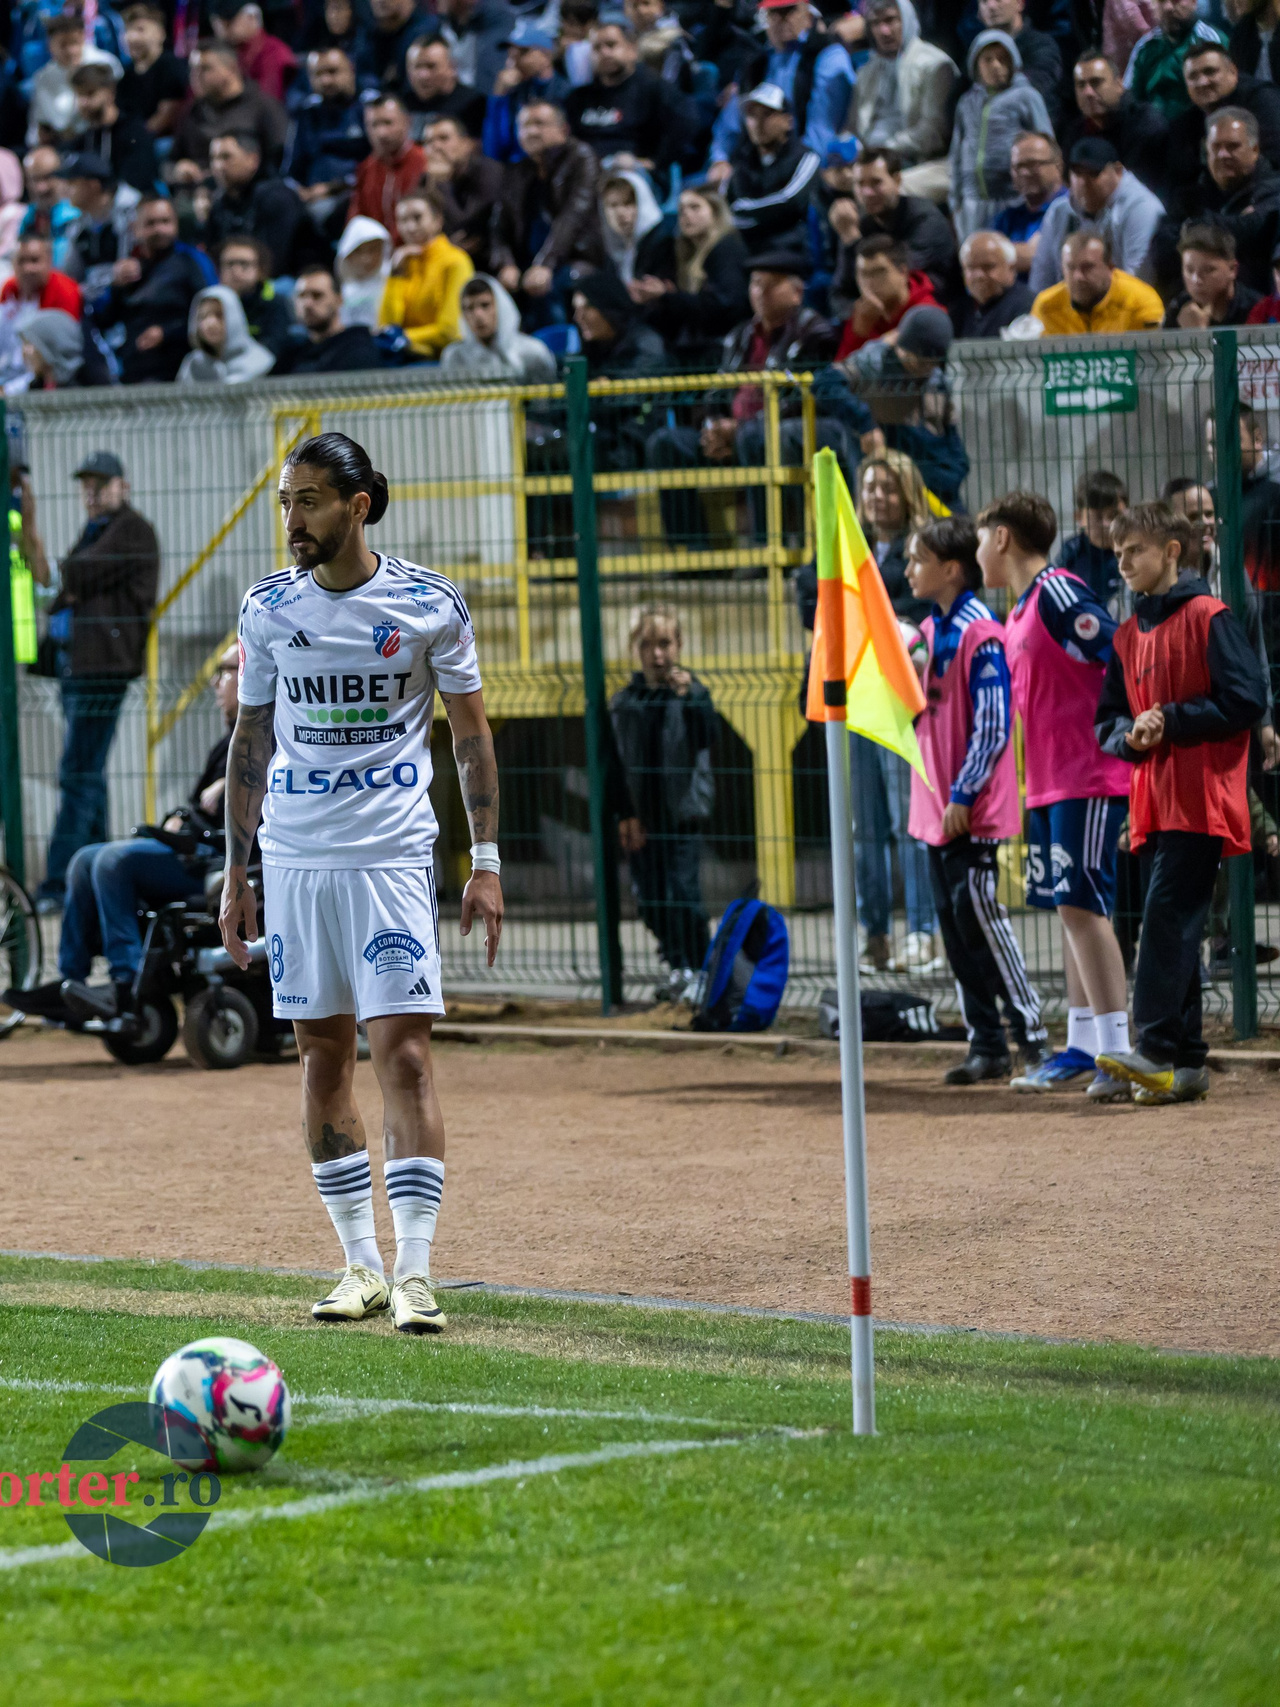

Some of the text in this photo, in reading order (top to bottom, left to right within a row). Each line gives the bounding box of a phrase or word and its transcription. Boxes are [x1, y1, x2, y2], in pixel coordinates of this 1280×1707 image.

[283, 672, 412, 704] UNIBET
[350, 729, 381, 743] SPRE
[382, 727, 401, 741] 0%
[269, 762, 419, 795] ELSACO
[366, 936, 423, 960] FIVE CONTINENTS
[276, 993, 308, 1005] Vestra
